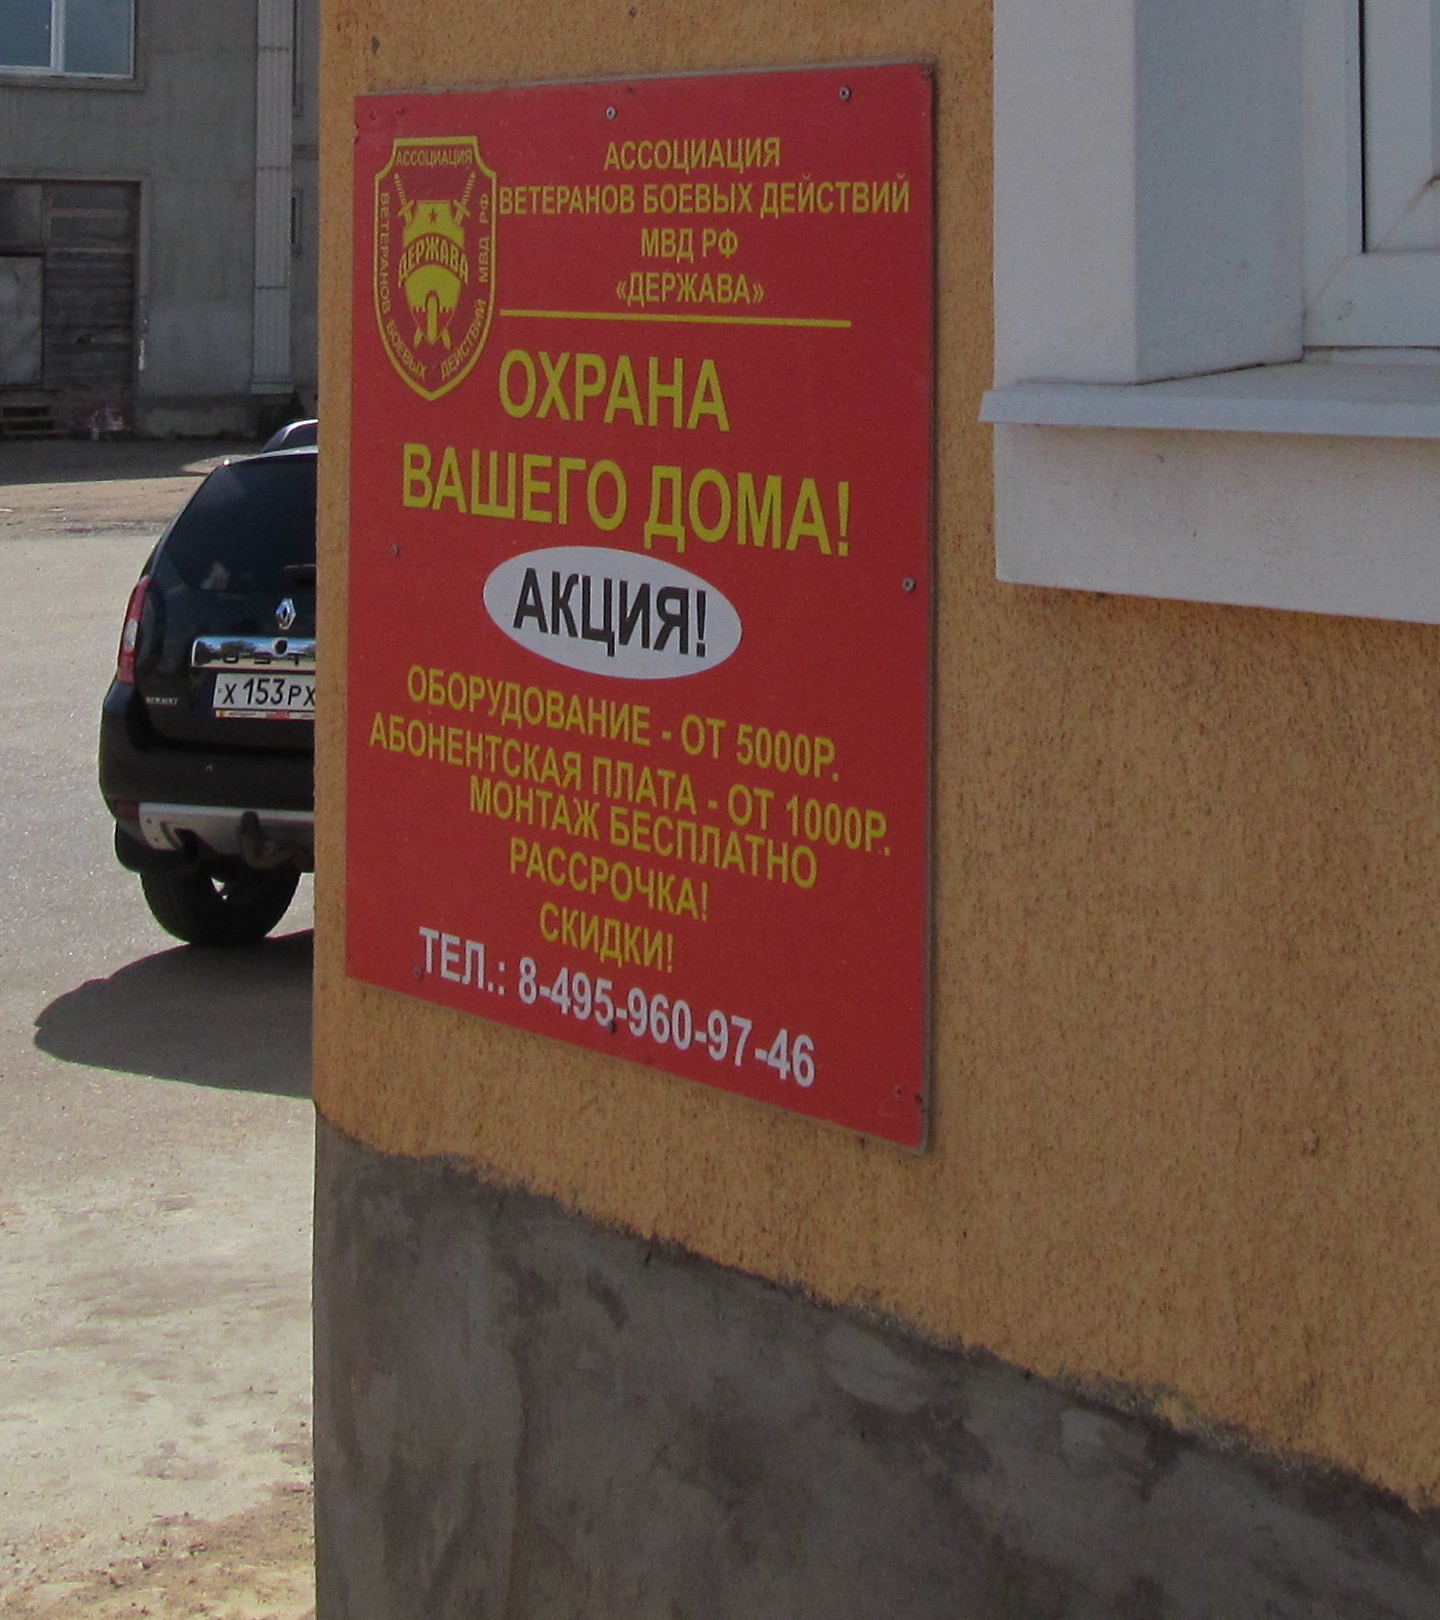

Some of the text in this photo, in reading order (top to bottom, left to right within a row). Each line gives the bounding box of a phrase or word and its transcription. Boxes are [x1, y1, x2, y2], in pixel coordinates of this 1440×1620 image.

[395, 148, 473, 168] АССОЦИАЦИЯ
[603, 137, 781, 174] АССОЦИАЦИЯ
[479, 193, 489, 224] РФ
[499, 172, 910, 219] ВЕТЕРАНОВ БОЕВЫХ ДЕЙСТВИЙ
[380, 192, 391, 314] ВЕТЕРАНОВ
[398, 236, 468, 288] ДЕРЖАВА
[478, 236, 490, 282] МВД
[641, 228, 739, 263] МВД РФ
[616, 272, 765, 308] «ДЕРЖАВА»
[499, 348, 730, 432] ОХРАНА
[403, 443, 849, 557] ВАШЕГО ДОМА!
[512, 567, 707, 657] АКЦИЯ!
[407, 664, 651, 746] ОБОРУДОВАНИЕ
[681, 715, 727, 759] ОТ
[736, 724, 839, 782] 5000Р.
[370, 712, 582, 789] АБОНЕНТСКАЯ
[593, 757, 697, 815] ПЛАТА
[728, 784, 774, 830] ОТ
[785, 796, 892, 856] 1000Р.
[470, 775, 818, 888] МОНТАЖ БЕСПЛАТНО
[510, 836, 709, 922] РАССРОЧКА!
[540, 902, 674, 974] СКИДКИ!
[419, 926, 815, 1087] ТЕЛ.: 8-495-960-97-46
